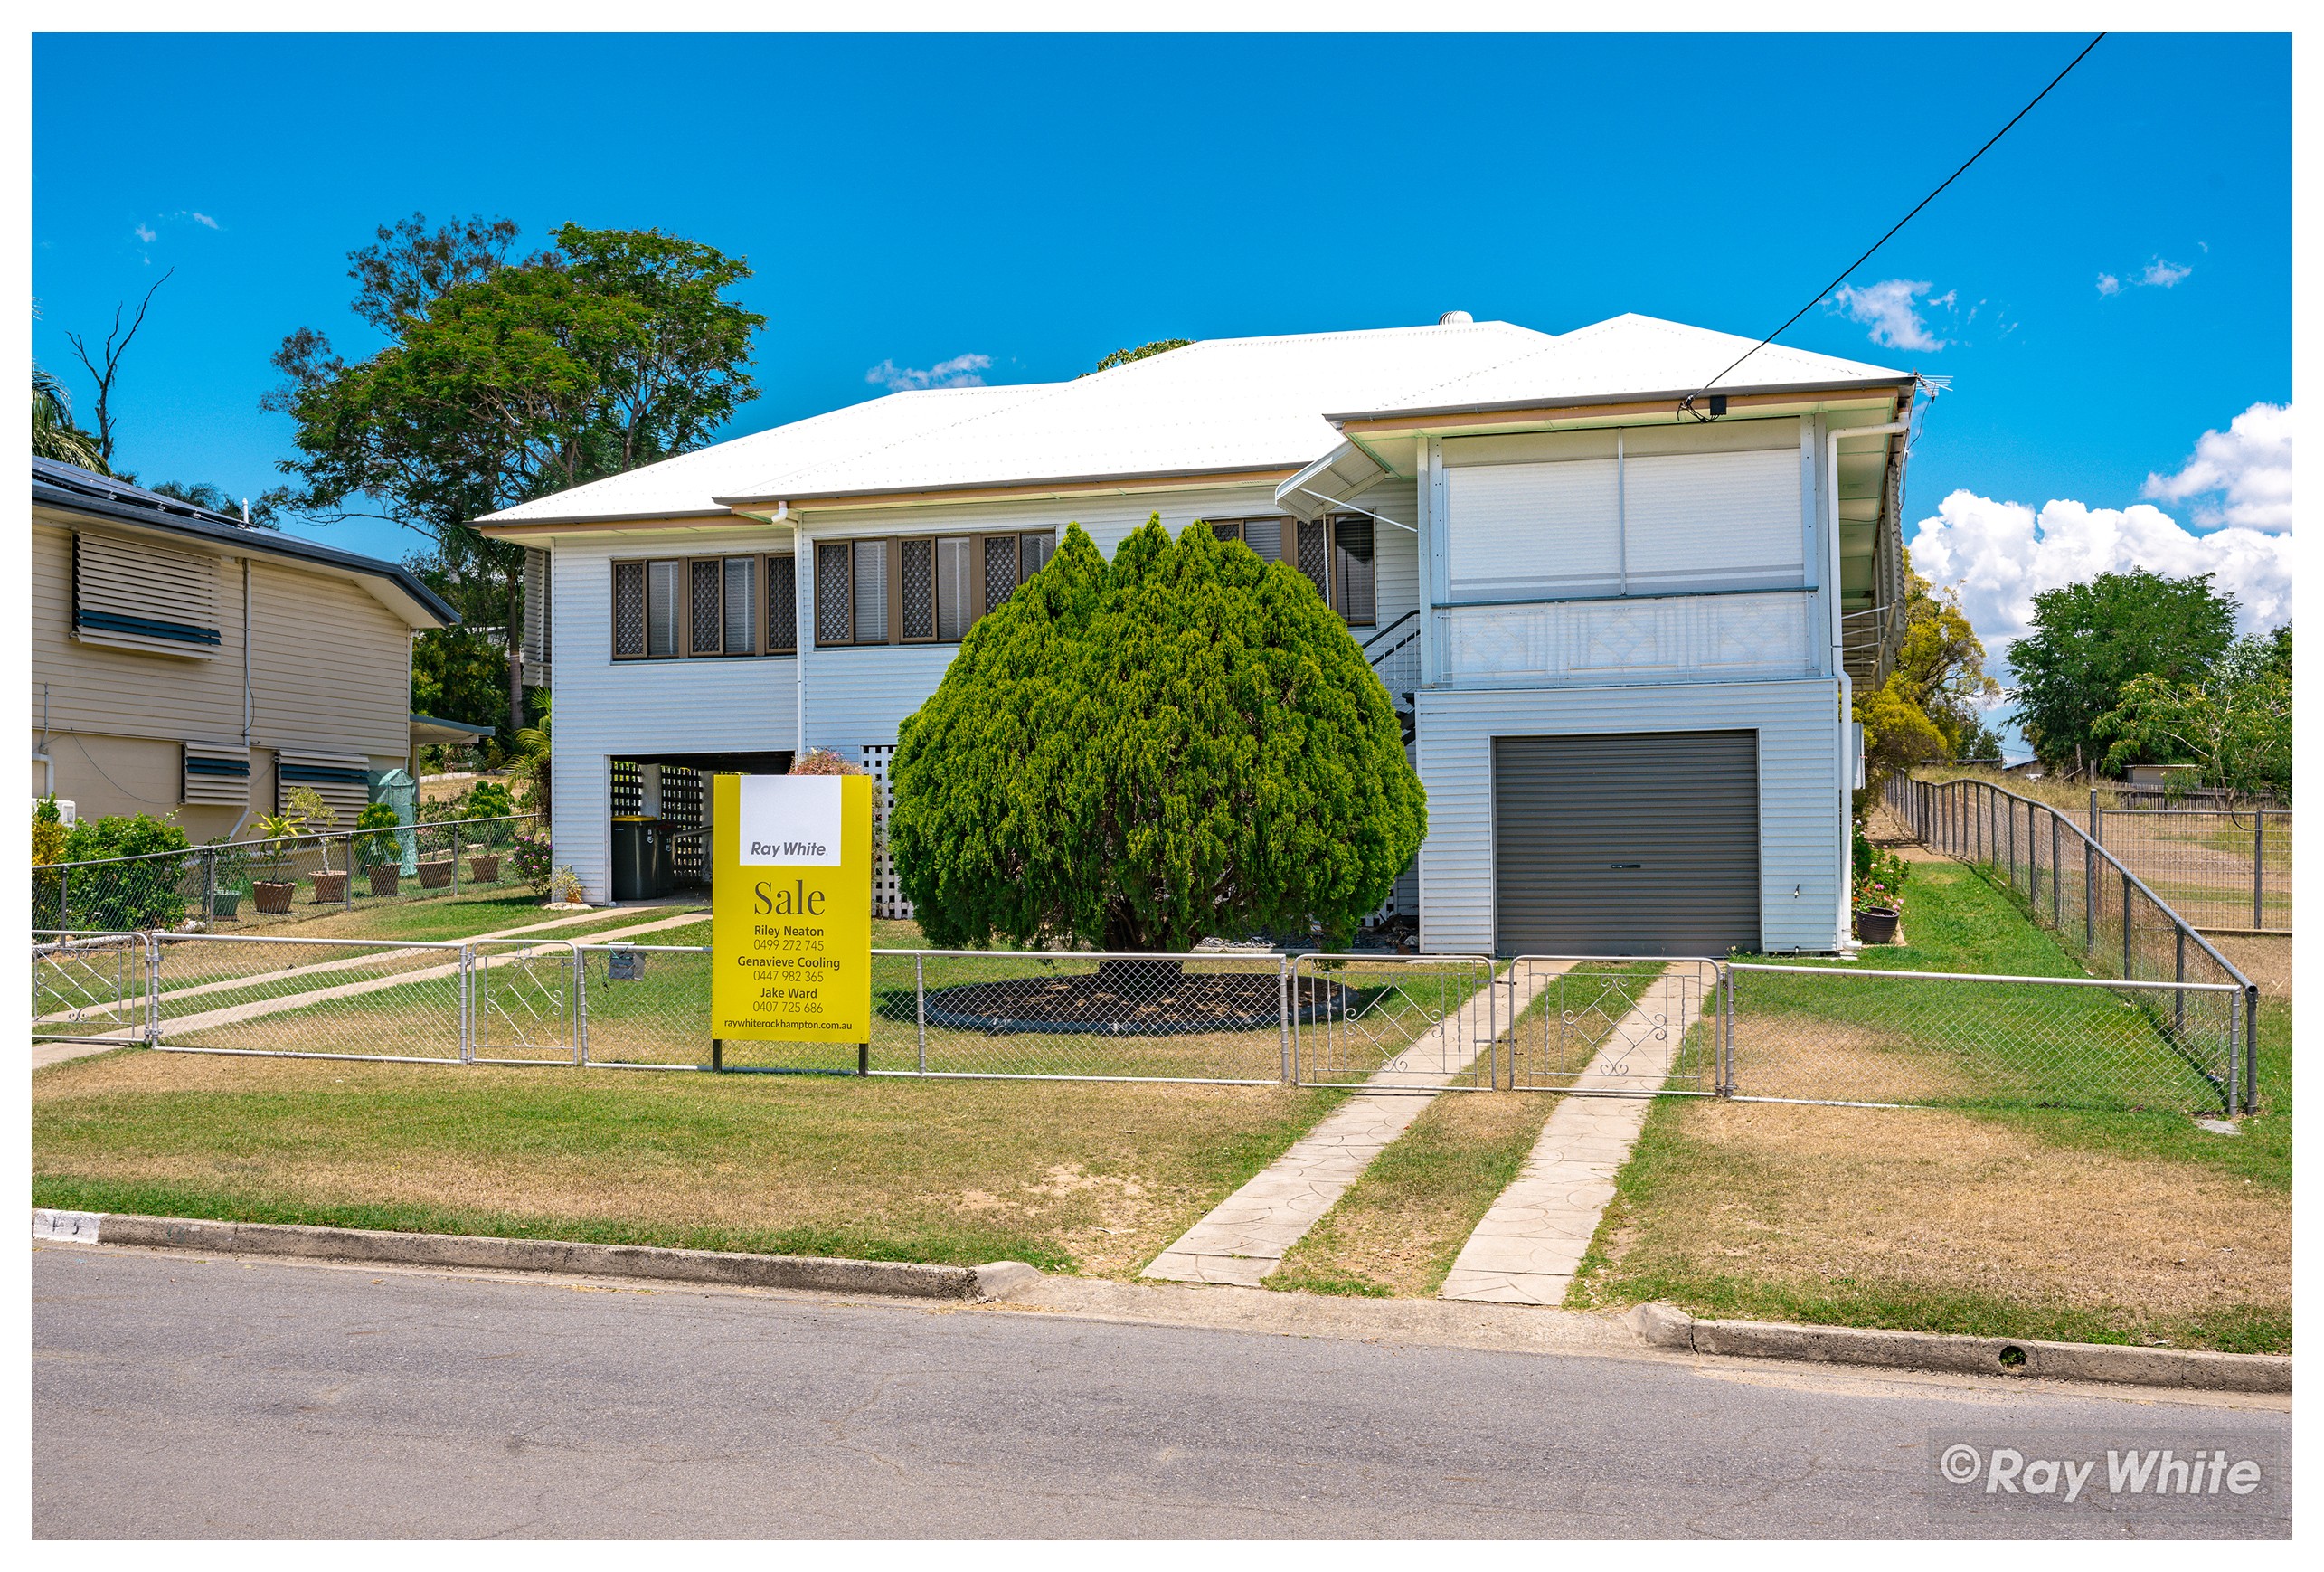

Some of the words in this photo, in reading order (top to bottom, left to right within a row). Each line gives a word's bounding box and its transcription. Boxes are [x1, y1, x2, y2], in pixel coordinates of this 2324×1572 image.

[751, 841, 780, 857] Ray
[783, 841, 827, 857] White
[754, 879, 826, 915] Sale
[754, 925, 781, 938] Riley
[784, 926, 824, 937] Neaton
[753, 939, 779, 951] 0499
[782, 940, 802, 952] 272
[805, 940, 825, 952] 745
[737, 956, 795, 968] Genavieve
[797, 957, 840, 971] Cooling
[753, 971, 779, 981] 0447
[781, 971, 802, 982] 982
[804, 971, 824, 983] 365
[760, 987, 785, 999] Jake
[788, 988, 817, 999] Ward
[752, 1001, 779, 1013] 0407
[781, 1001, 801, 1014] 725
[803, 1002, 824, 1014] 686
[723, 1018, 853, 1031] raywhiterockhampton.com.au
